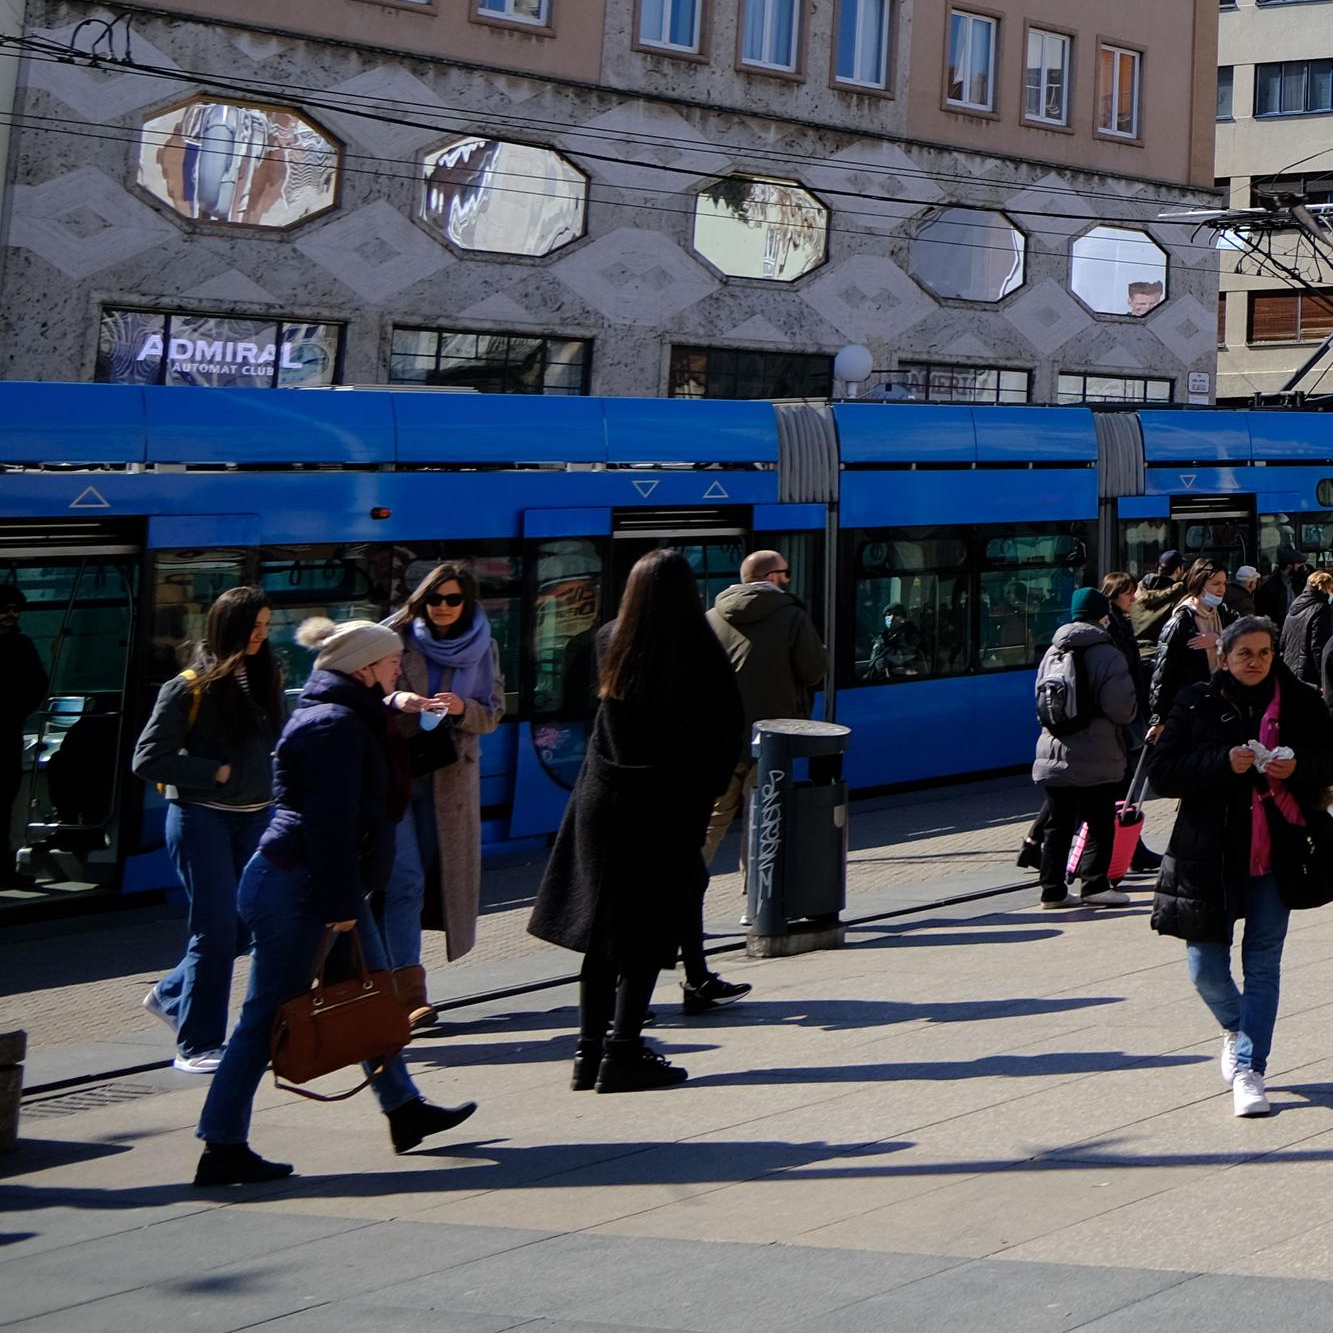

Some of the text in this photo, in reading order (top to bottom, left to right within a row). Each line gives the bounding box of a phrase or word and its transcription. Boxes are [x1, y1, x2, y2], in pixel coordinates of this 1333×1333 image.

[136, 334, 303, 368] ADMIRAL
[172, 362, 275, 376] AUTOMAT CLUB
